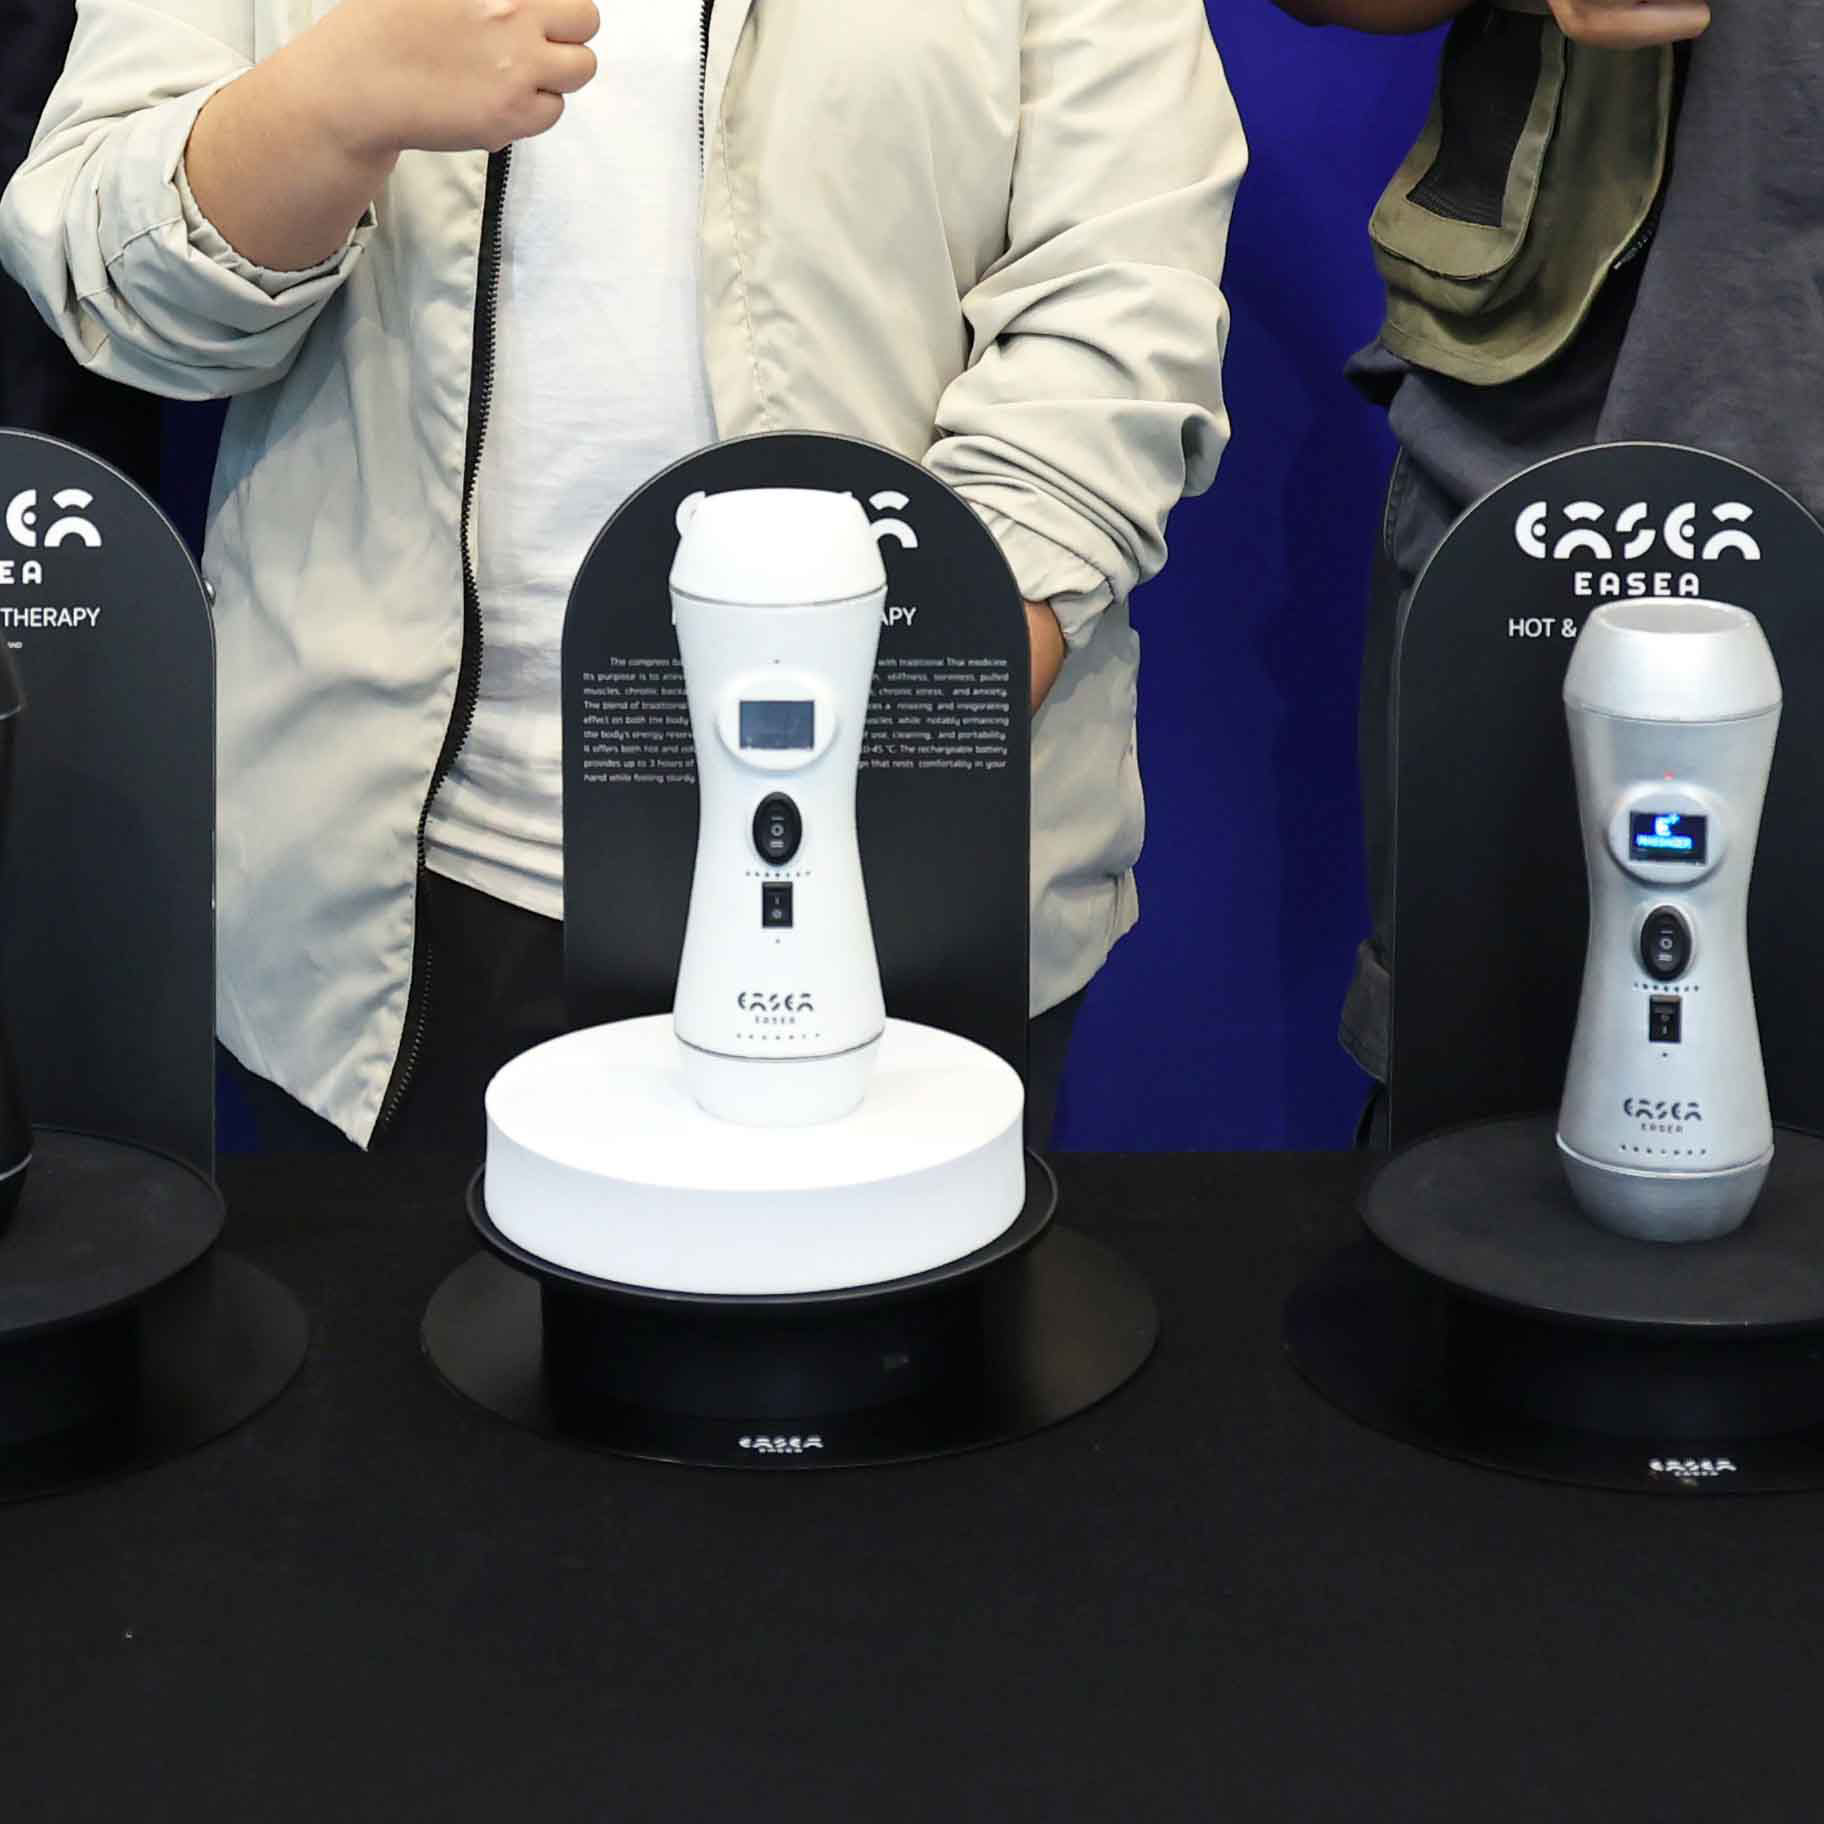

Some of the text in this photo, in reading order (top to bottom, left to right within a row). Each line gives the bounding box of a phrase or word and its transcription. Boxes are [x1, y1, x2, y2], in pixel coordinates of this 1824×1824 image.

[1574, 571, 1700, 597] EASEA
[0, 607, 101, 627] THERAPY
[1508, 617, 1555, 638] HOT
